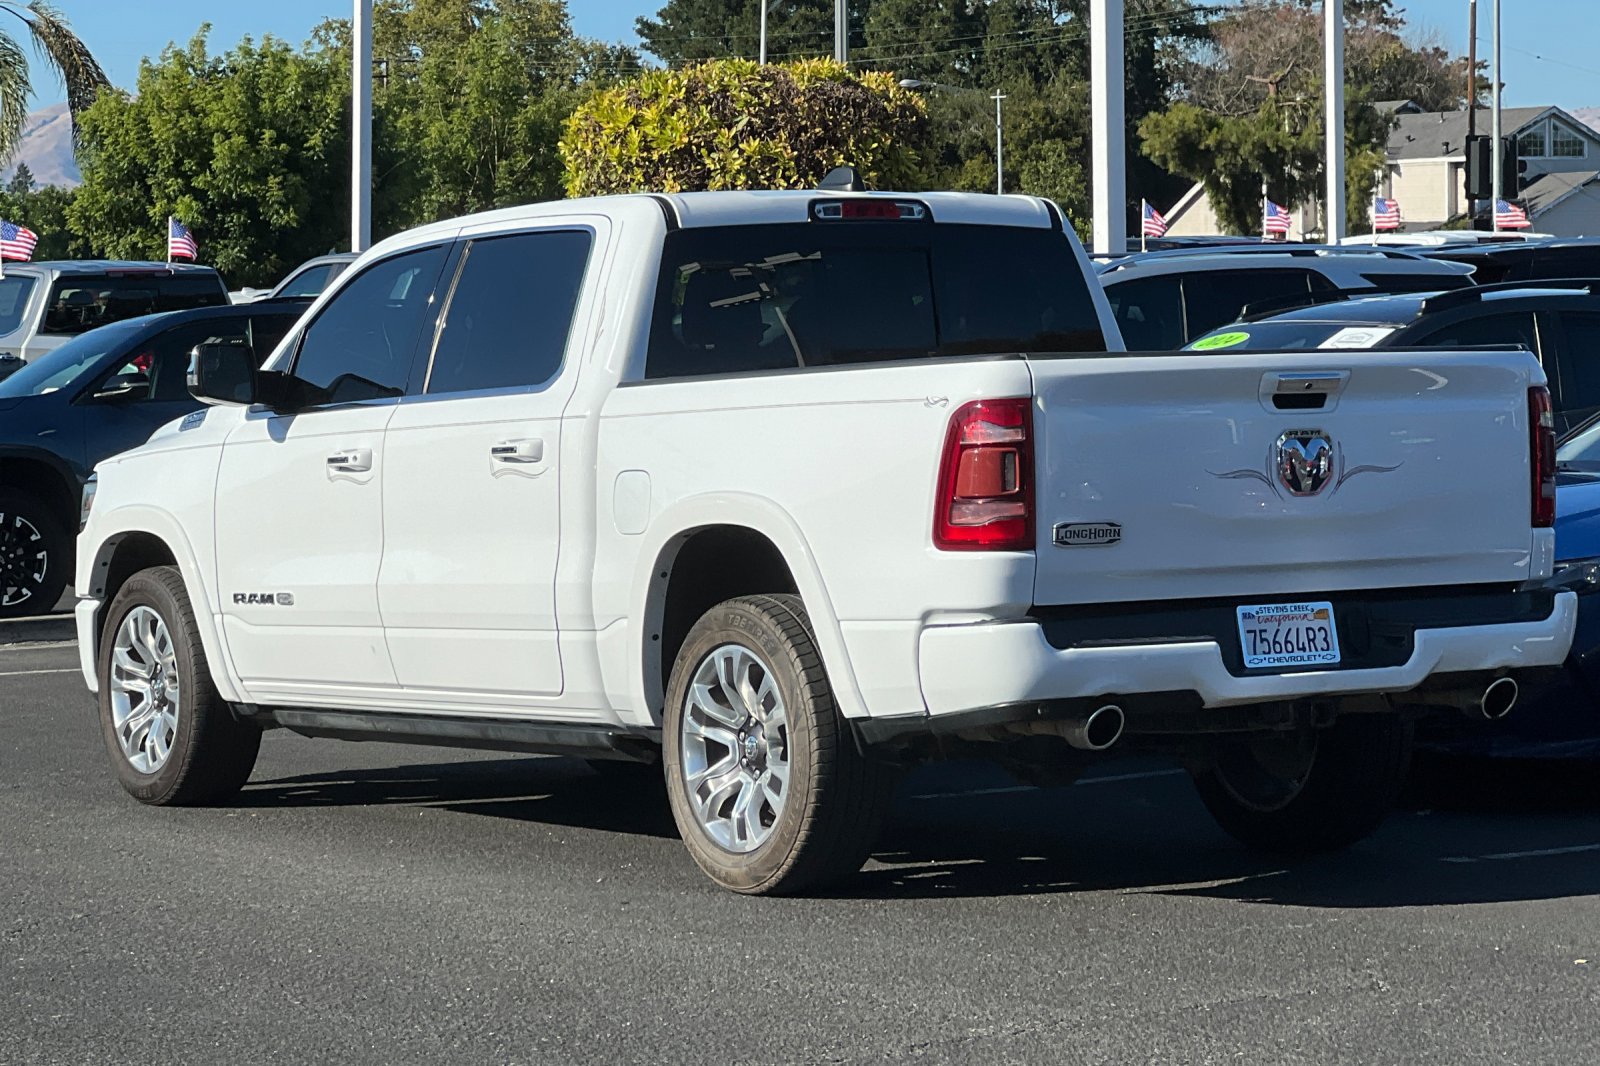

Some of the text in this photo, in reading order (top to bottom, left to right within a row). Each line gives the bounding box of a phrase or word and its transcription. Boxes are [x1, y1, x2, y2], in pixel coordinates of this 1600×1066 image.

[233, 593, 275, 605] RAM
[1258, 604, 1309, 614] STEVENS CREEK
[1246, 626, 1330, 655] 75664R3
[1267, 654, 1317, 664] CHEVROLET
